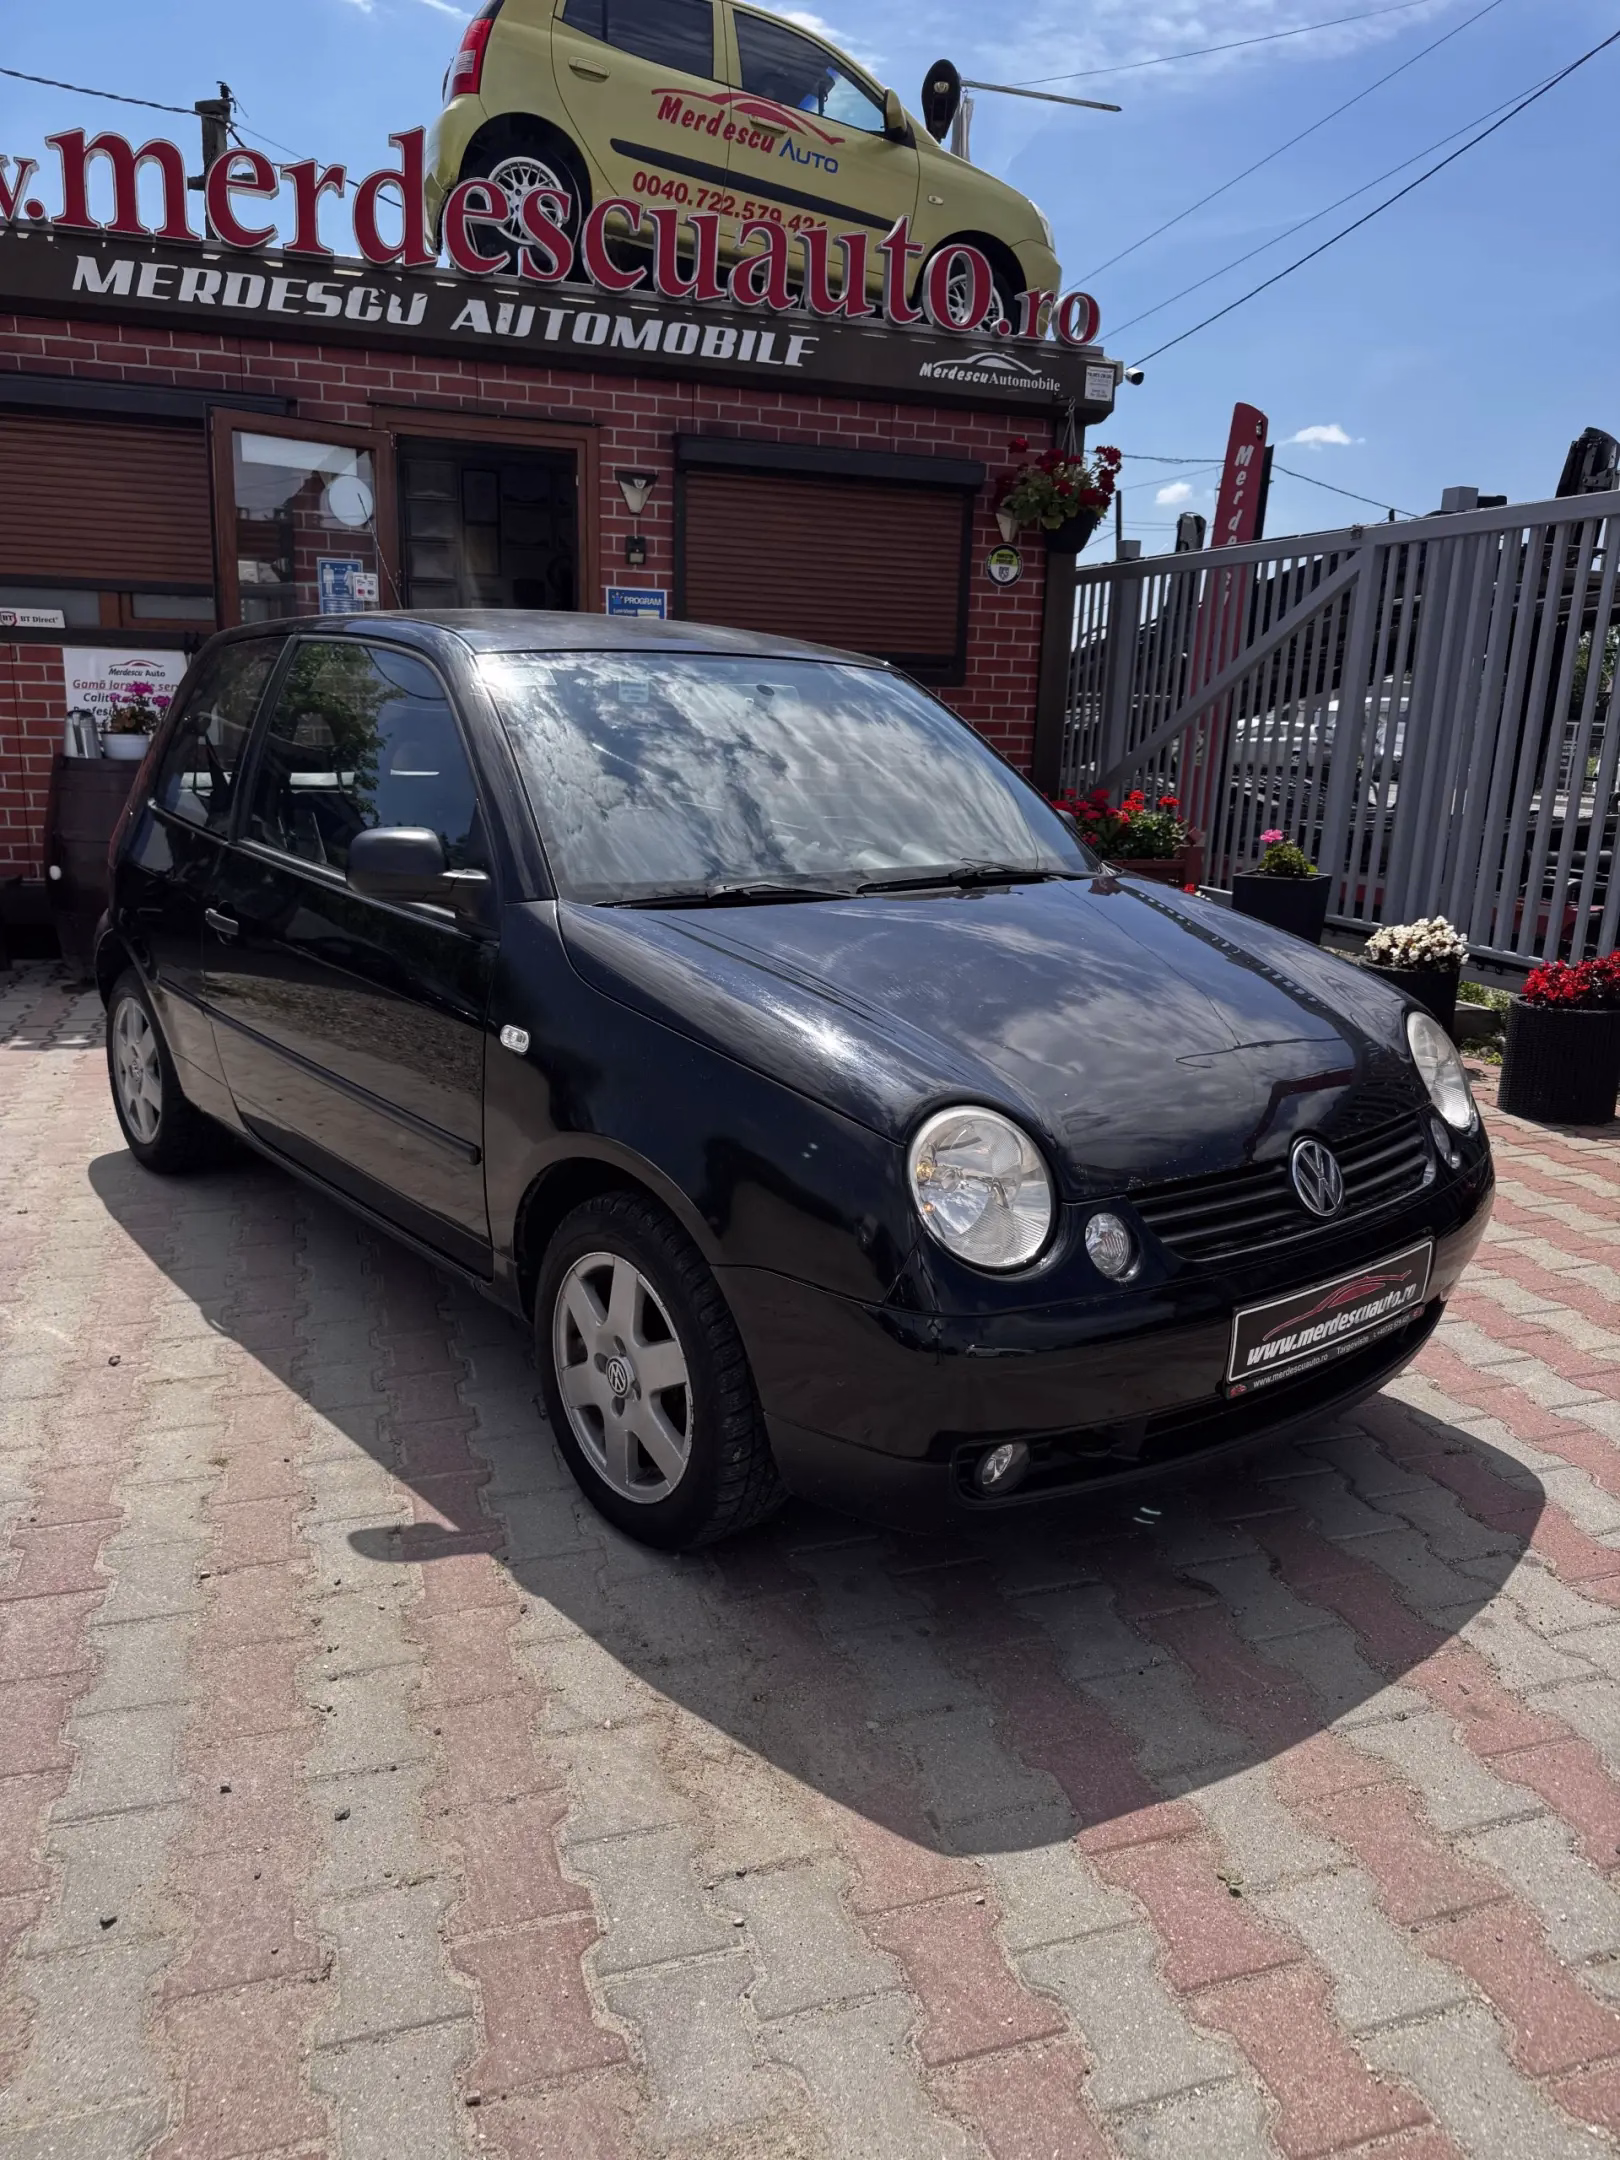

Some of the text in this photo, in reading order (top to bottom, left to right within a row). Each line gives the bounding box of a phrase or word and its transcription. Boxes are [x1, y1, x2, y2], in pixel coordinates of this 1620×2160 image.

[657, 95, 839, 174] Merdescu AUTO
[632, 171, 827, 234] 0040.722.579.42
[72, 255, 819, 367] MERDESCU AUTOMOBILE
[20, 615, 30, 623] BT
[624, 596, 662, 606] PROGRAM
[108, 668, 166, 677] Merdescu Auto
[1246, 1283, 1417, 1366] www.merdescuauto.ro
[1253, 1353, 1329, 1389] www.merdescuauto.ro
